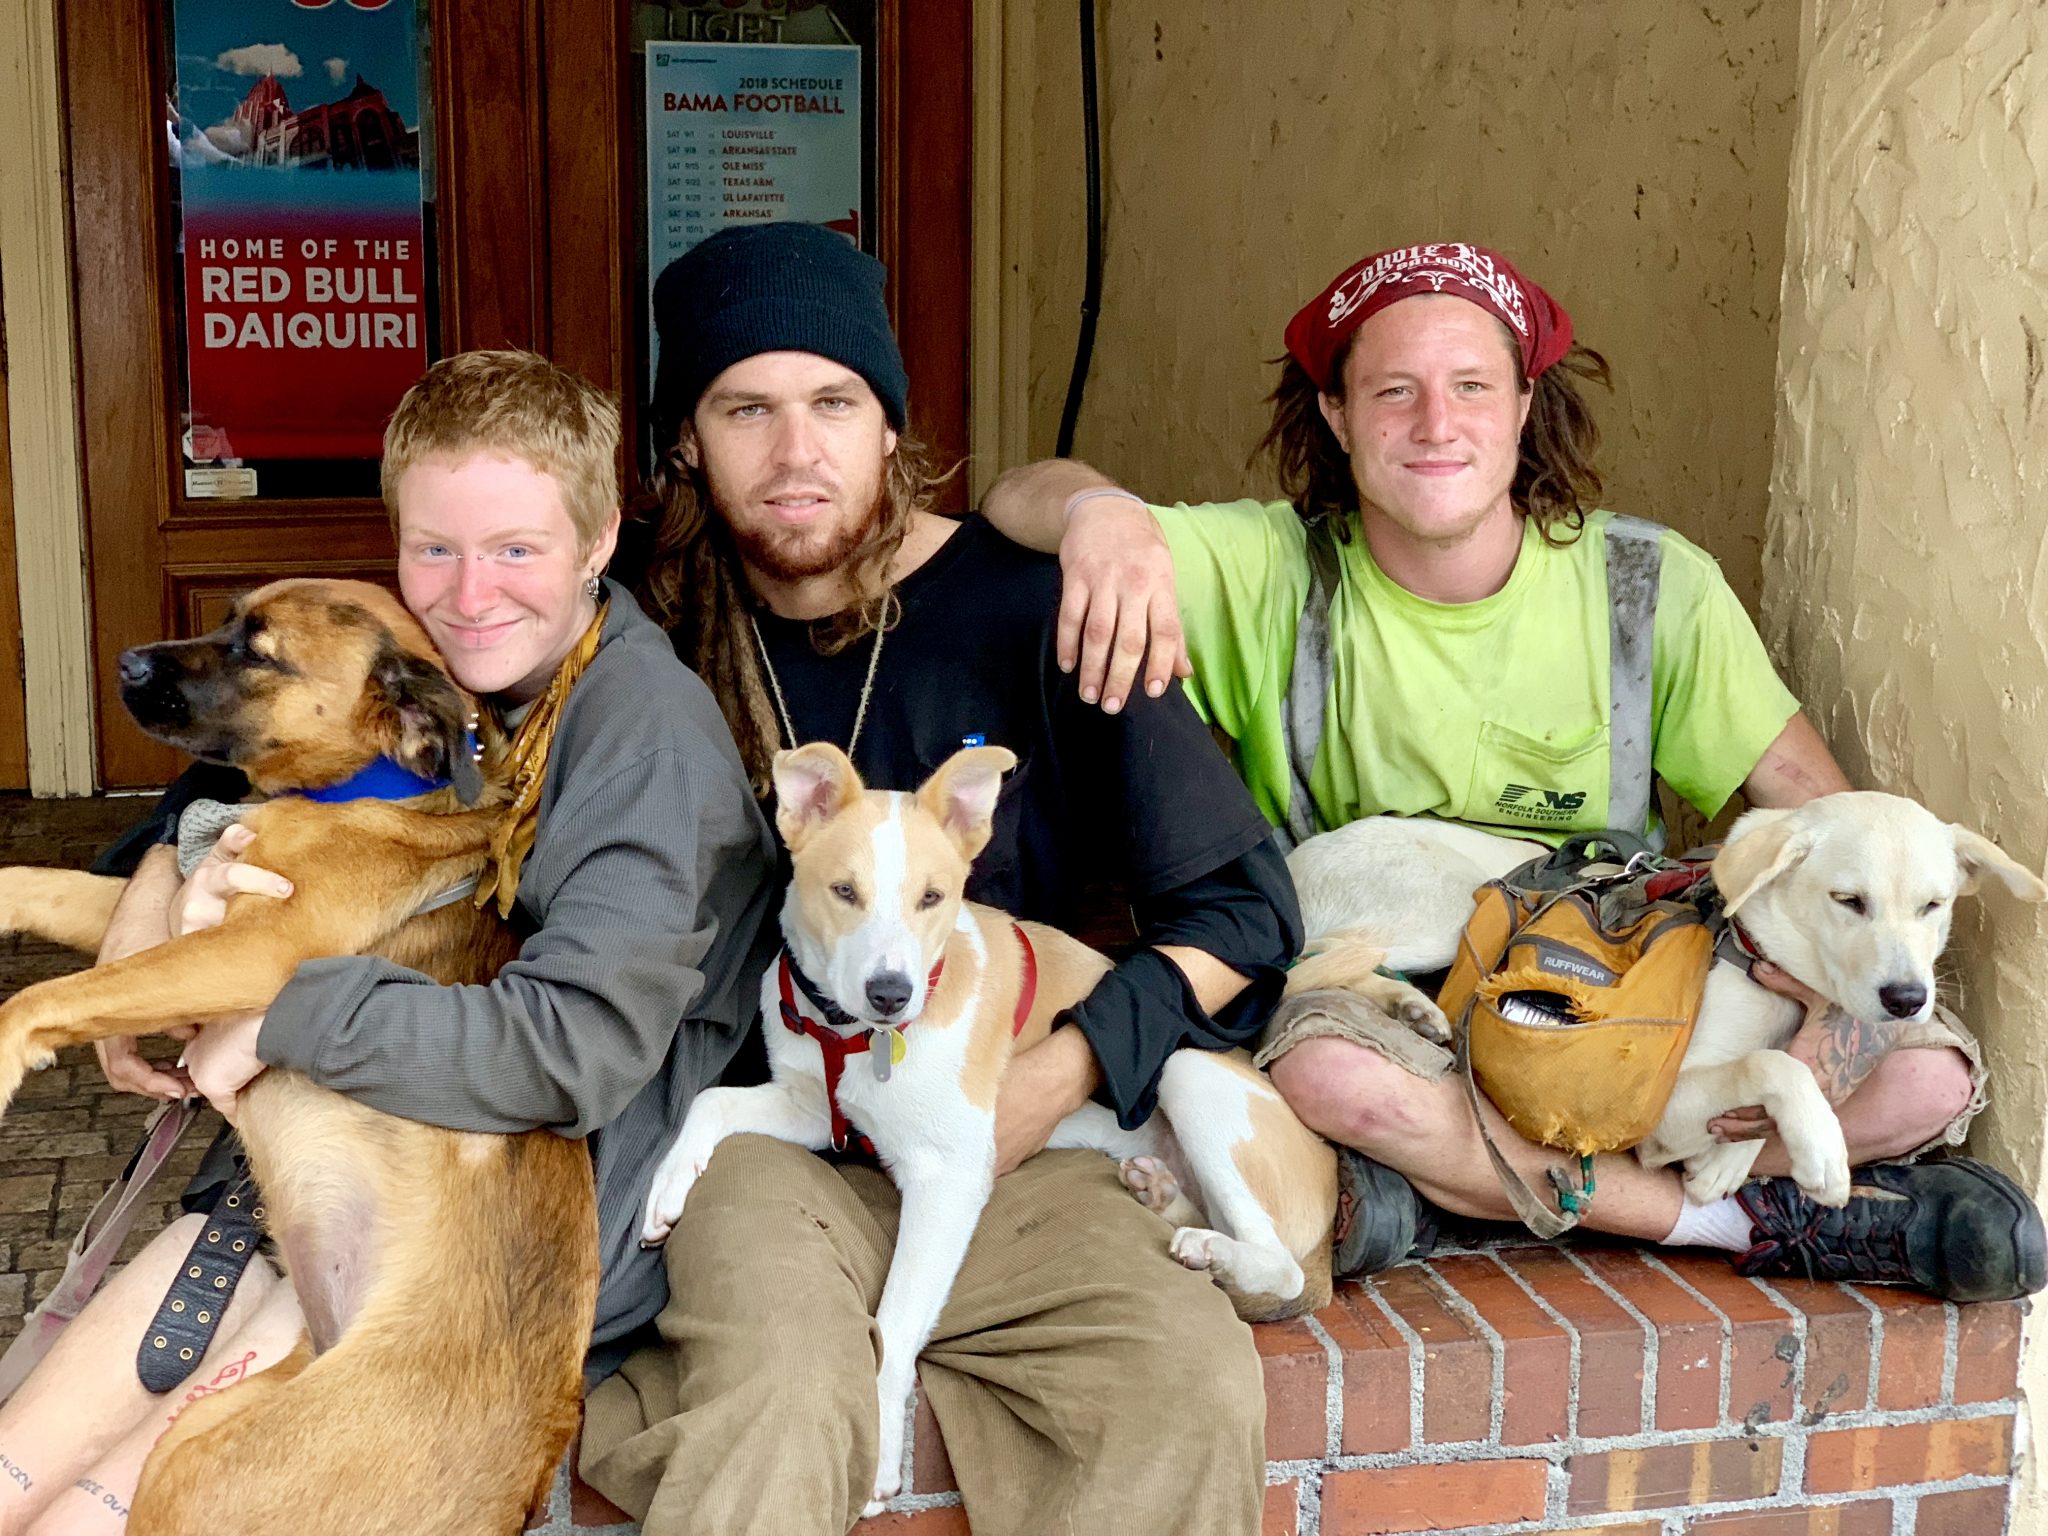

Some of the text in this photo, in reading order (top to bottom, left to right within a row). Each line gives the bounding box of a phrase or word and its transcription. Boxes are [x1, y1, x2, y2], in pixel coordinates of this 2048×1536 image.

[668, 11, 787, 42] LIGHT
[739, 78, 843, 91] 2018 SCHEDULE
[663, 92, 845, 114] BAMA FOOTBALL
[722, 161, 741, 171] OLE
[722, 177, 750, 187] TEXAS
[722, 193, 735, 203] UL
[200, 238, 410, 260] HOME OF THE
[202, 266, 417, 304] RED BULL
[203, 312, 417, 348] DAIQUIRI
[1494, 800, 1579, 816] NORFOLK SOUTHERN
[1498, 808, 1573, 821] ENGINEERING
[1543, 956, 1606, 982] RUFFWEAR
